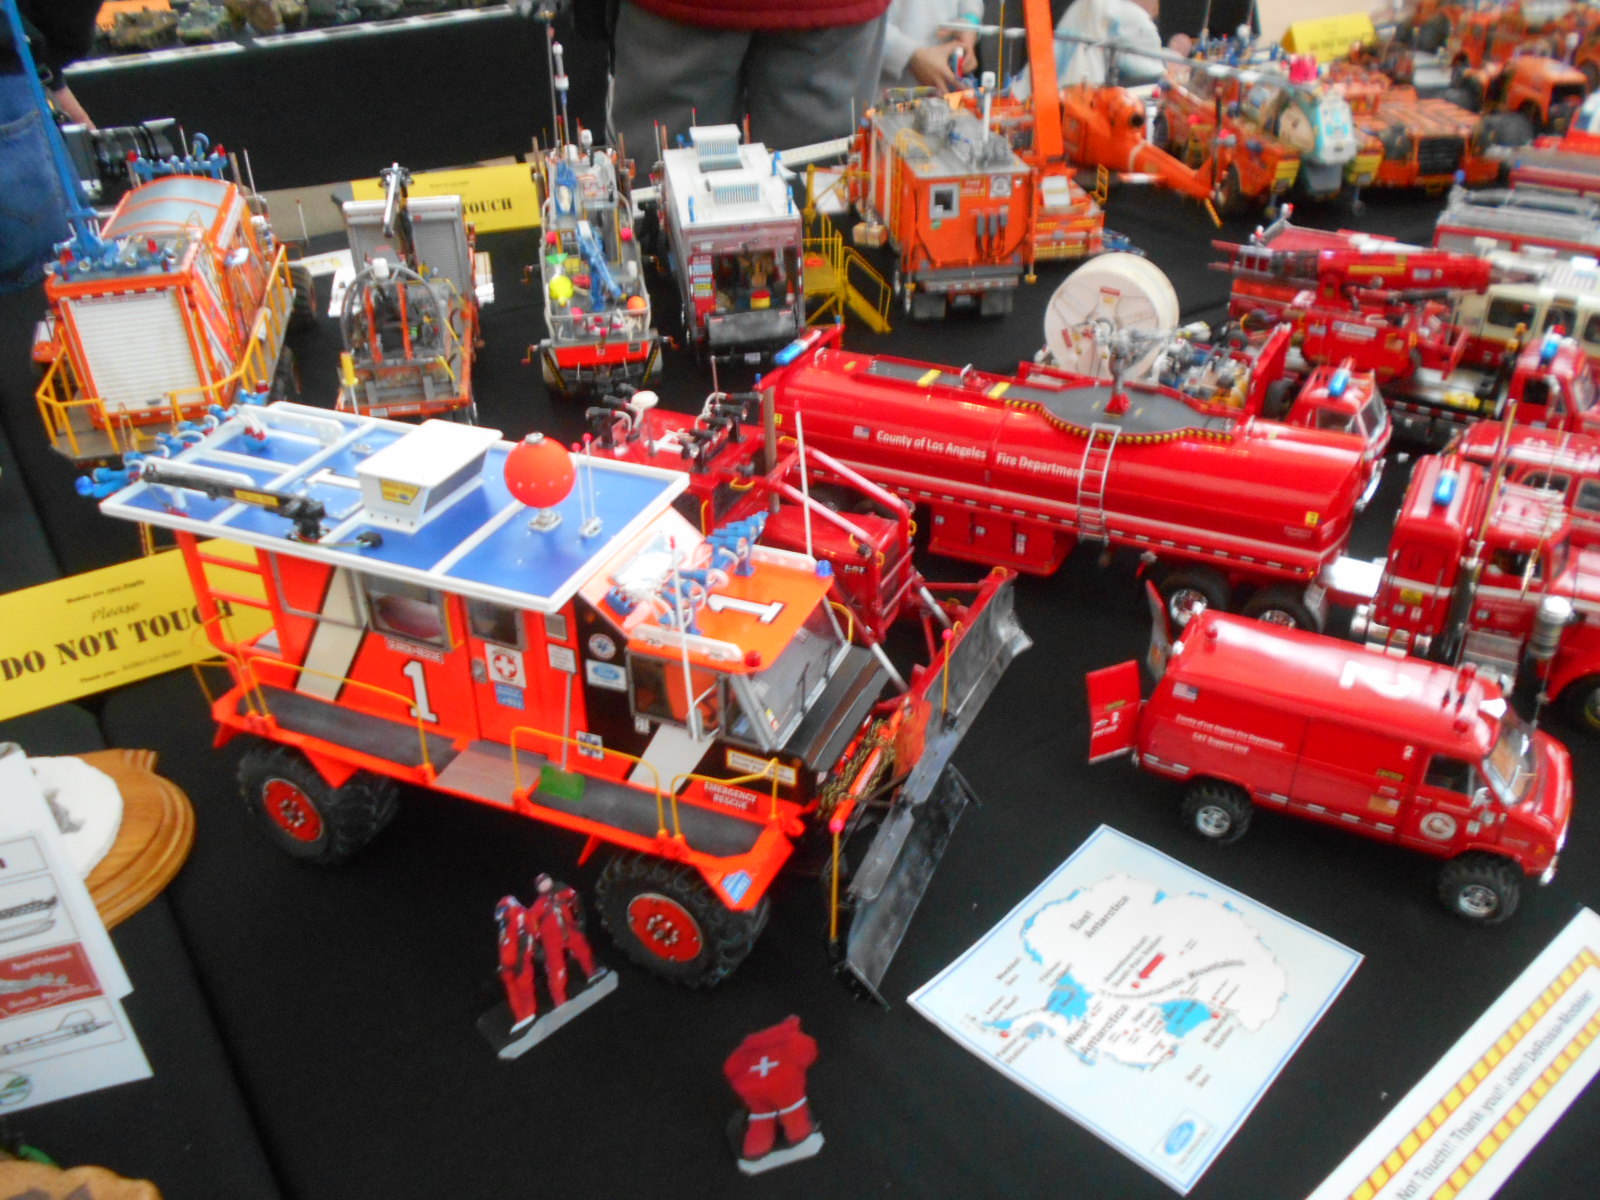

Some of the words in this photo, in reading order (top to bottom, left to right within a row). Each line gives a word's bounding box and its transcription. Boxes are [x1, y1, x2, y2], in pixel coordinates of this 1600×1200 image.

[877, 429, 912, 450] County
[914, 435, 925, 449] of
[926, 437, 944, 451] Los
[945, 441, 987, 461] Angeles
[996, 452, 1017, 467] Fire
[1018, 455, 1084, 480] Departmen
[91, 601, 142, 623] Please
[706, 594, 785, 624] 1
[0, 650, 46, 681] DO
[55, 628, 119, 665] NOT
[128, 598, 235, 643] TOUCH
[403, 660, 438, 723] 1
[703, 780, 758, 804] EMERGENCY
[1069, 910, 1094, 932] East
[1084, 894, 1130, 939] Antarctica
[1064, 1016, 1092, 1045] West
[1080, 1004, 1130, 1054] Antarctica
[1396, 1178, 1418, 1200] Not
[1413, 1136, 1456, 1181] Touch!!
[1450, 1111, 1484, 1142] Thank
[1483, 1083, 1508, 1115] you!!
[1506, 1061, 1529, 1087] John
